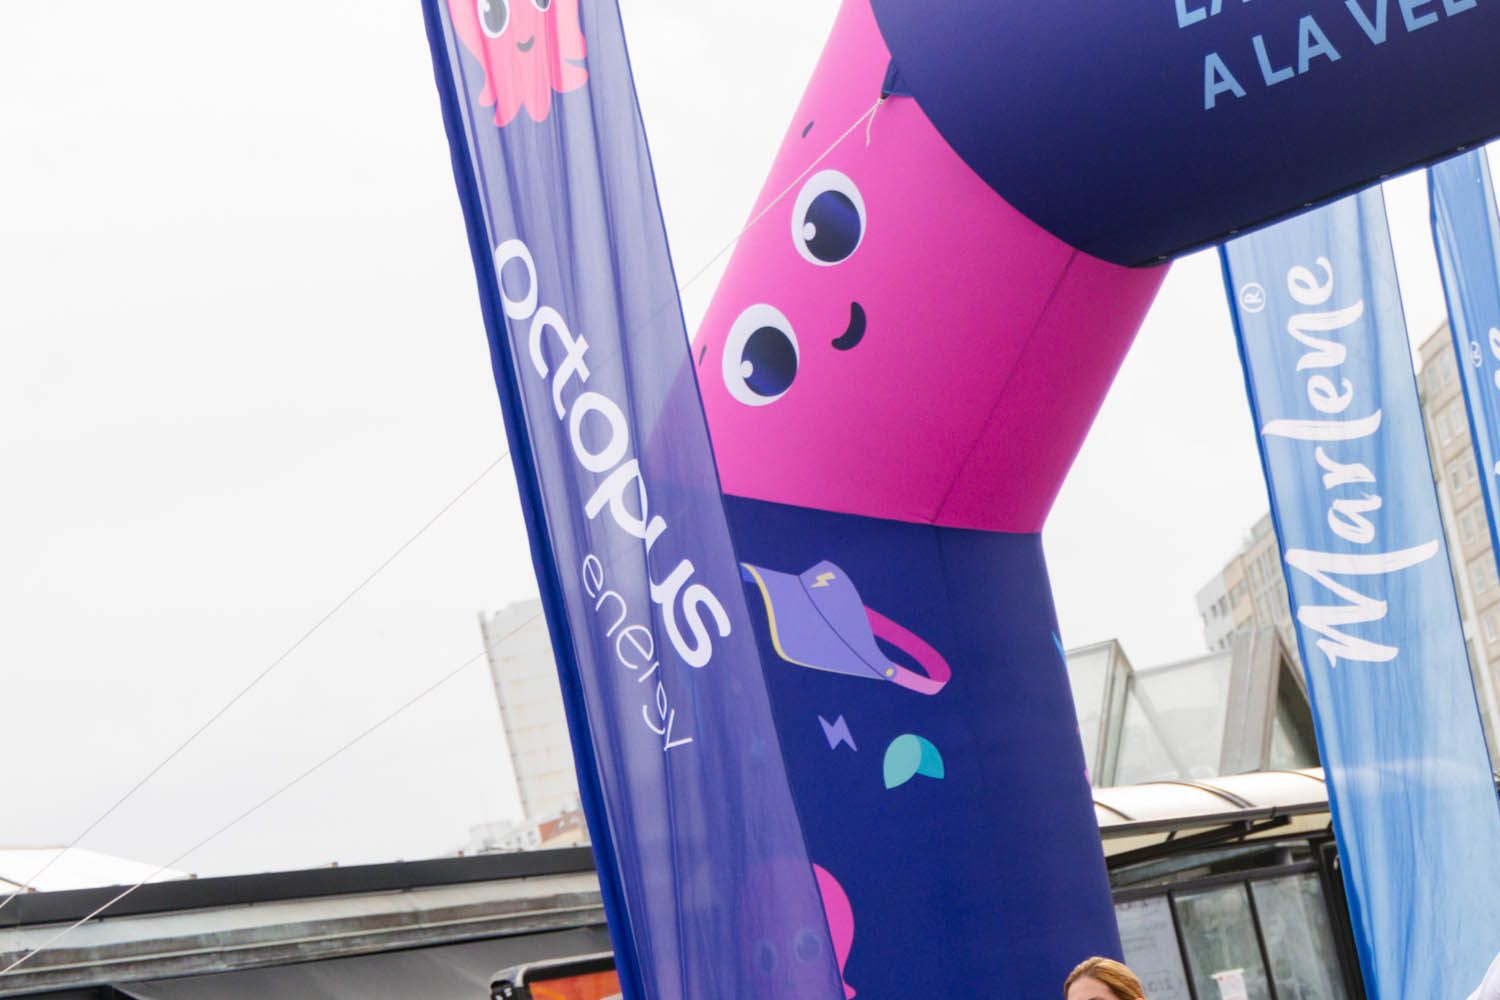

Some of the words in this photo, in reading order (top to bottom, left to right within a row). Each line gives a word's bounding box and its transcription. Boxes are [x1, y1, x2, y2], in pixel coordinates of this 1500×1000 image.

[1204, 52, 1247, 110] A
[1252, 15, 1342, 86] LA
[495, 238, 732, 668] octopus
[1261, 256, 1439, 668] Marlene
[582, 553, 693, 752] energy
